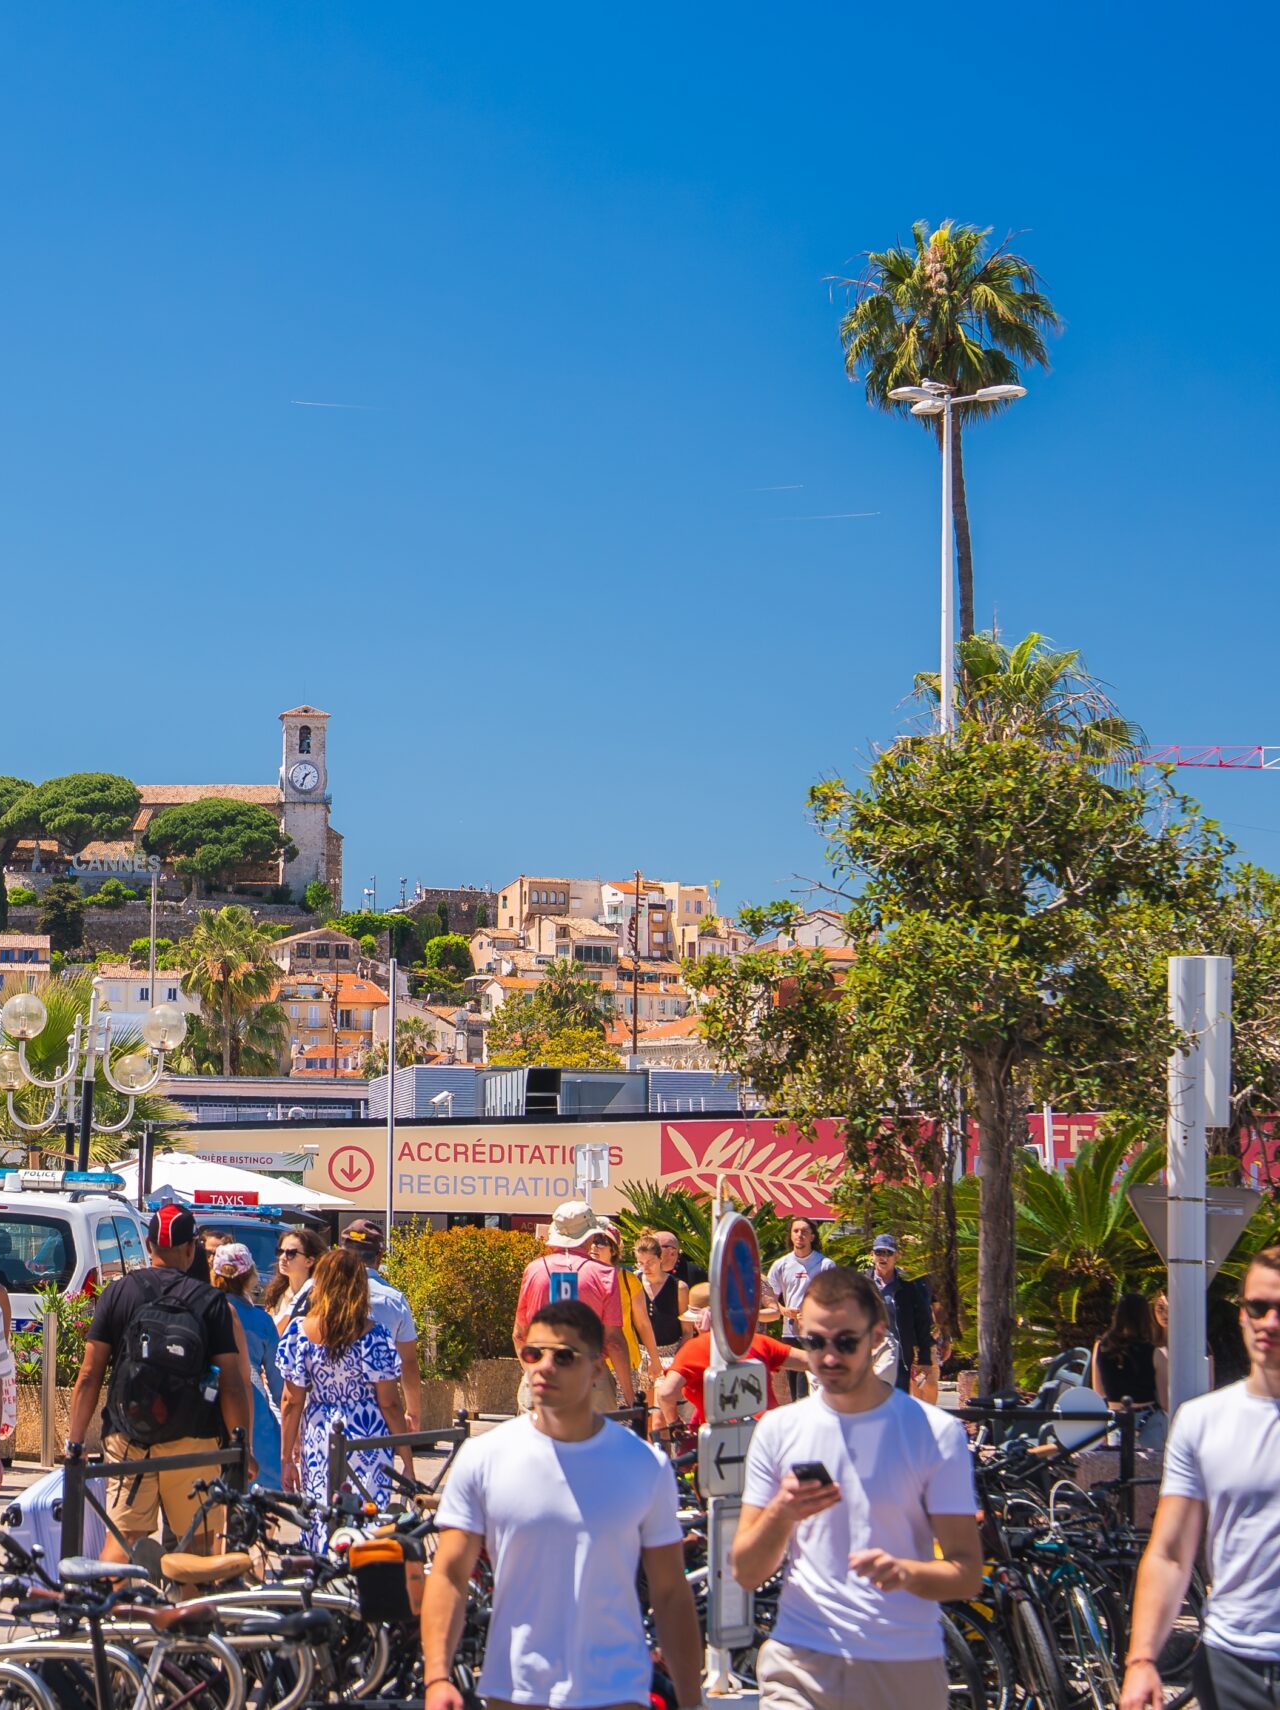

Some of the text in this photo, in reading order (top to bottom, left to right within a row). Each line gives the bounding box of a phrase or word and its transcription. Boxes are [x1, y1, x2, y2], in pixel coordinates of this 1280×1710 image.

[72, 852, 161, 873] CANNES
[397, 1138, 624, 1166] ACCRÉDITATIS
[230, 1156, 274, 1165] BISTINGO
[210, 1194, 244, 1205] TAXIS
